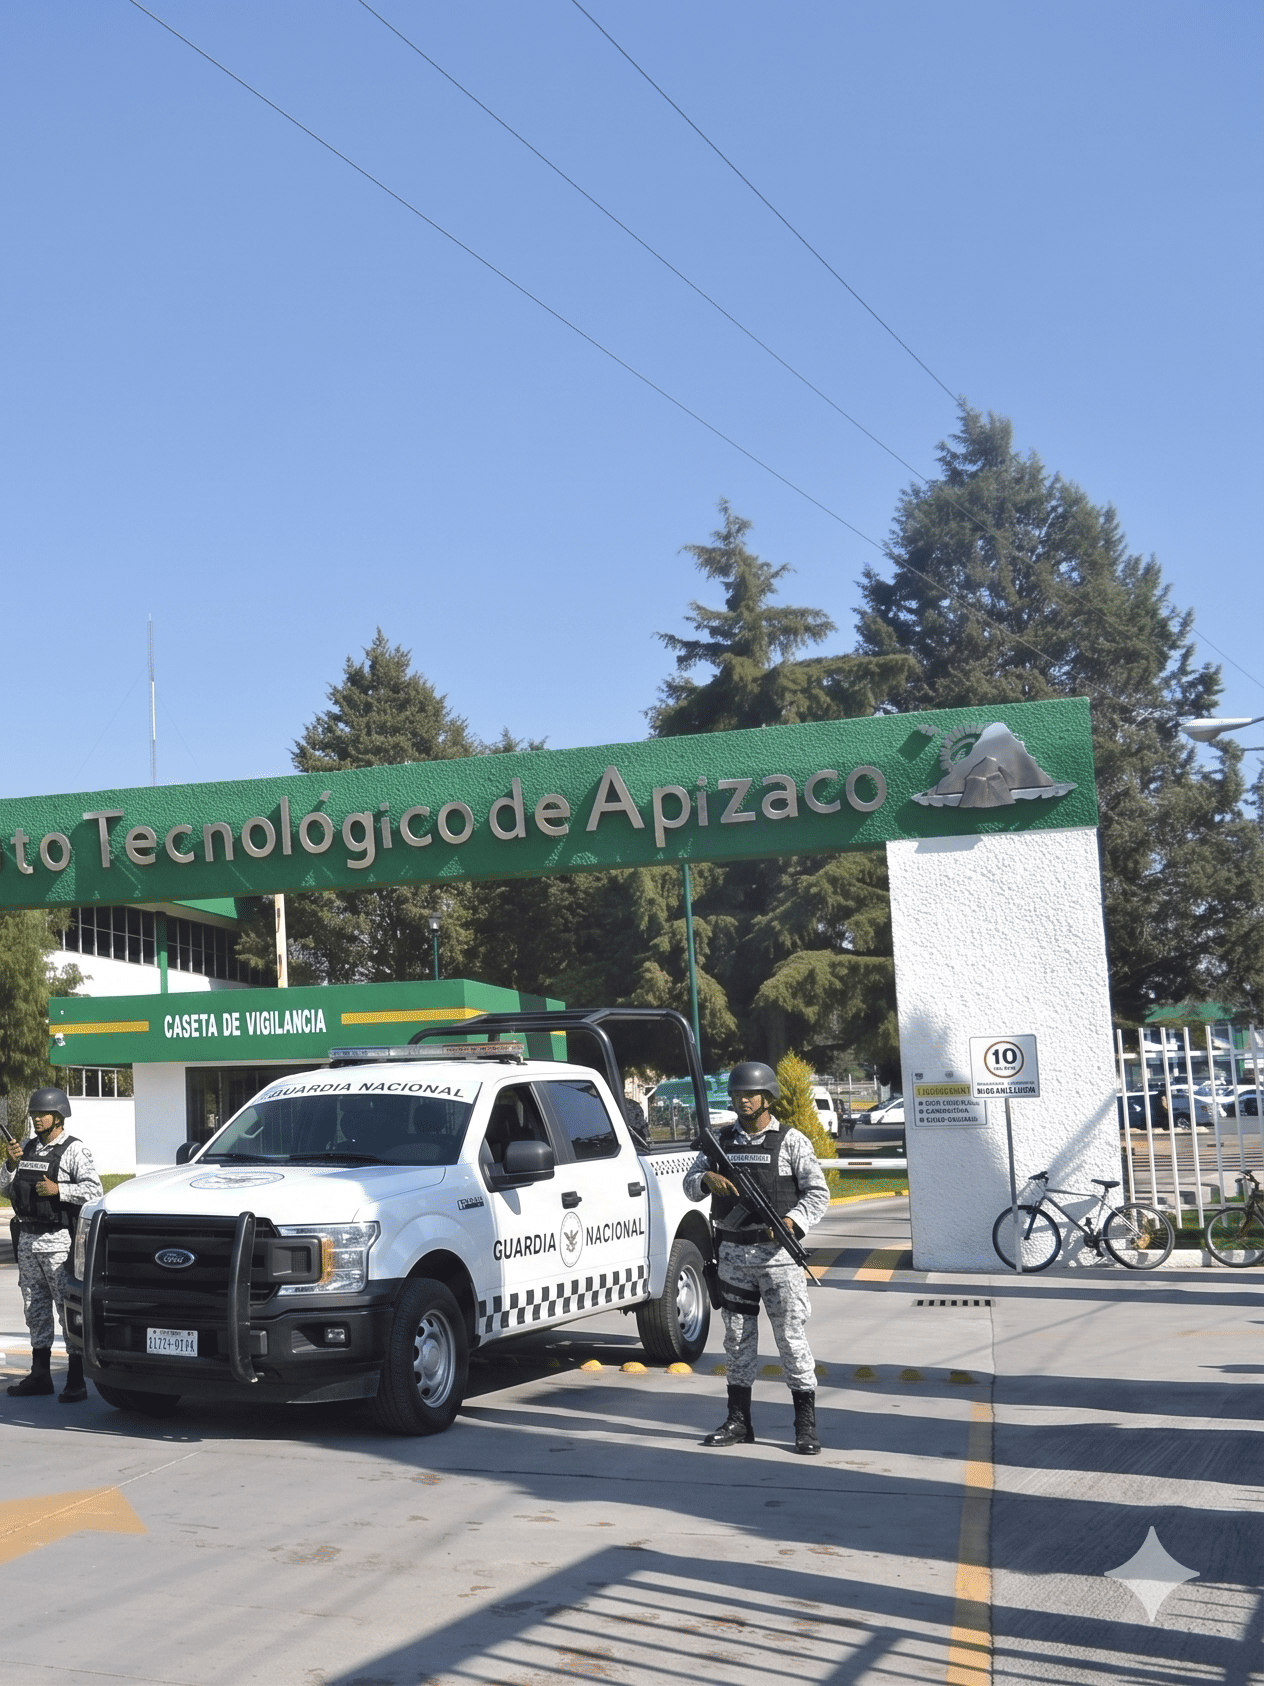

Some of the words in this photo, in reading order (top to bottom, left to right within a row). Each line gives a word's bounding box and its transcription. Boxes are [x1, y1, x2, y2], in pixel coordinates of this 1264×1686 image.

[83, 790, 474, 870] Tecnológico
[489, 777, 570, 840] de
[586, 765, 888, 848] Apizaco
[164, 1013, 217, 1039] CASETA
[223, 1012, 240, 1037] DE
[246, 1009, 327, 1036] VIGILANCIA
[992, 1047, 1018, 1065] 10
[358, 1082, 465, 1098] NACIONAL
[493, 1232, 557, 1261] GUARDIA
[586, 1217, 645, 1247] NACIONAL
